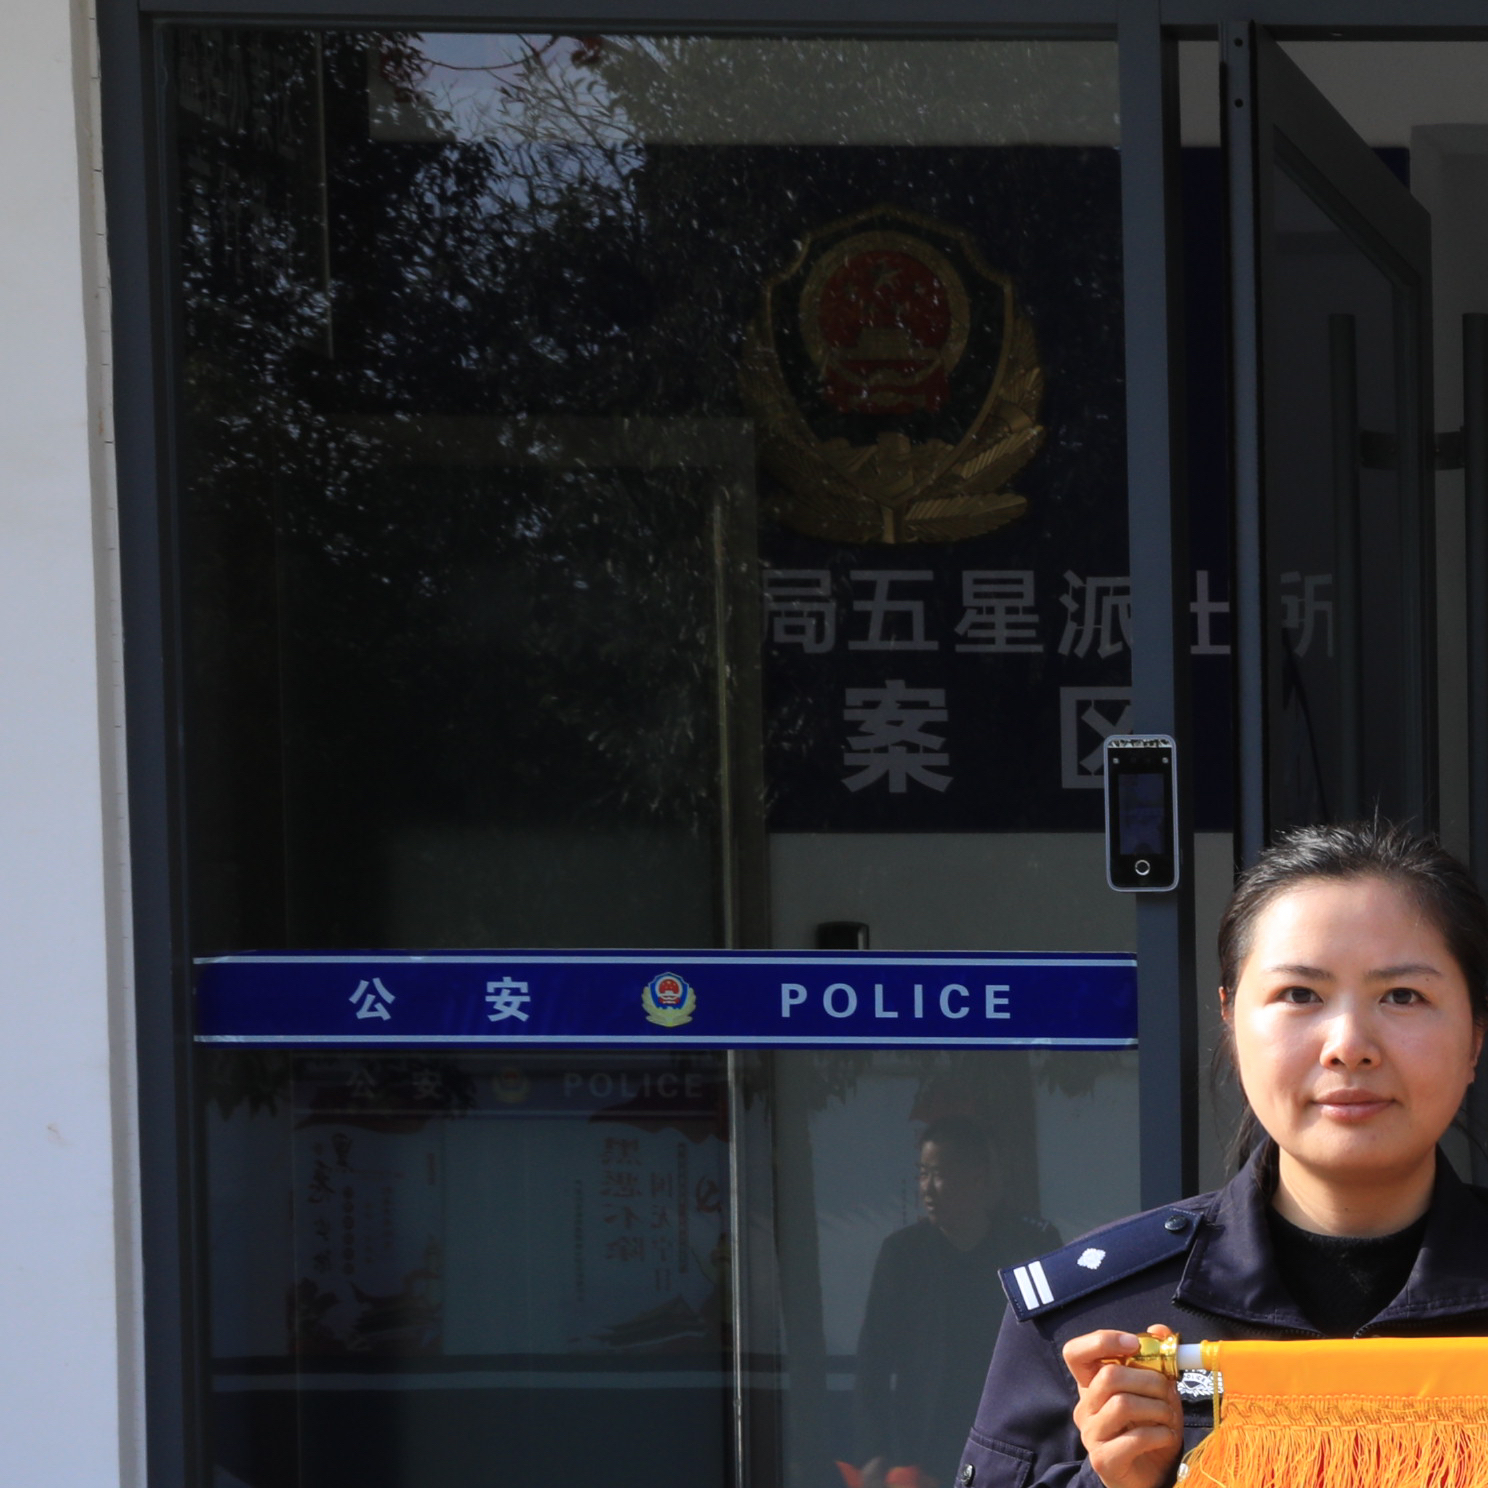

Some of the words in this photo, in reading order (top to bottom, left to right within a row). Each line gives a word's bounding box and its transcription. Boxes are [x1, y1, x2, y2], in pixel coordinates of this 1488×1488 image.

[350, 977, 531, 1022] 公安
[782, 984, 1012, 1019] POLICE
[563, 1072, 704, 1099] POLICE
